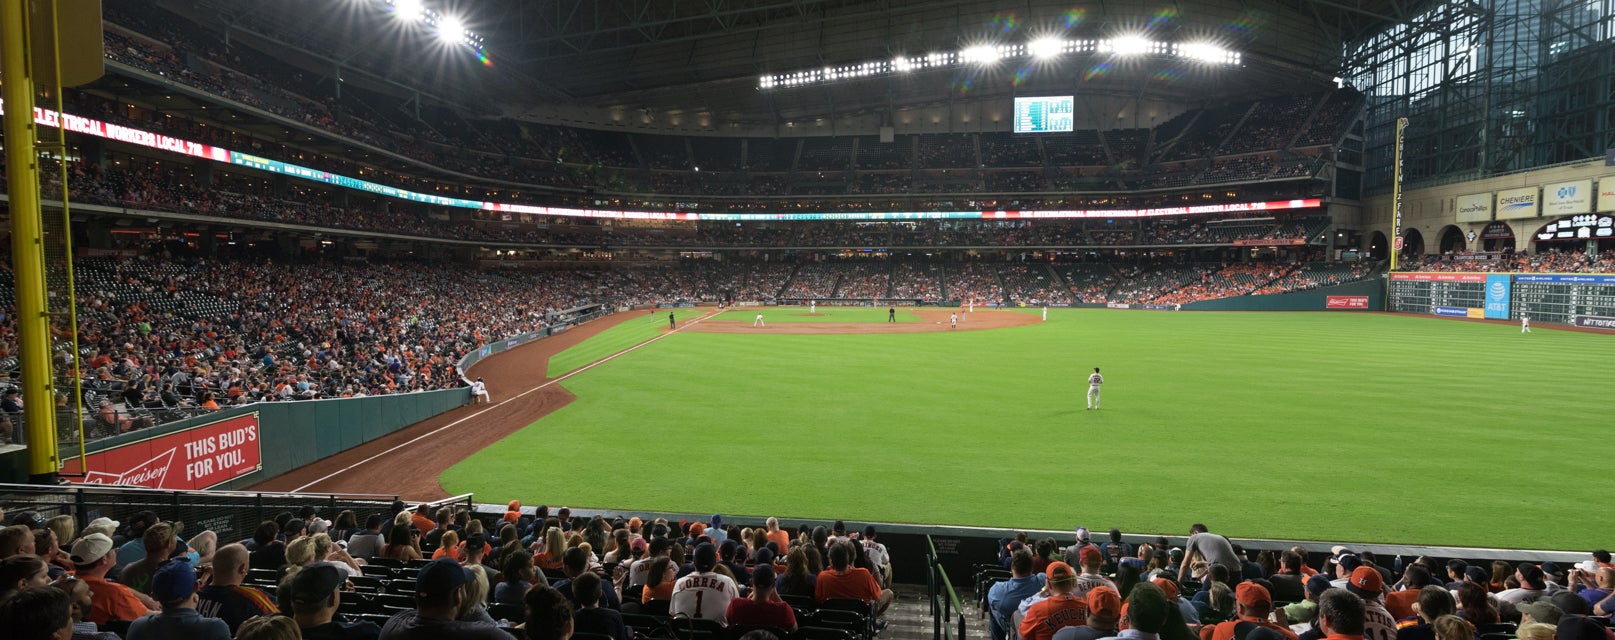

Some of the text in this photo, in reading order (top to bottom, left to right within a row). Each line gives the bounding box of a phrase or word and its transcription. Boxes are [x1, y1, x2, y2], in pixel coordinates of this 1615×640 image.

[33, 107, 106, 137] ELECTRICAL
[106, 123, 155, 147] WORKERS
[157, 134, 186, 154] LOCAL
[1500, 195, 1535, 205] CHENIERE
[1148, 207, 1190, 216] ELECTRICAL
[1460, 204, 1488, 214] ConocoPhillips
[1488, 303, 1506, 311] AT&T
[184, 425, 256, 460] THIS BUD'S
[186, 458, 213, 481] FOR
[216, 448, 245, 471] YOU.
[679, 576, 725, 592] CORREA
[199, 599, 222, 617] YAN
[693, 590, 703, 618] 1
[1045, 607, 1086, 631] KEUCH
[1366, 611, 1392, 628] ATTIS
